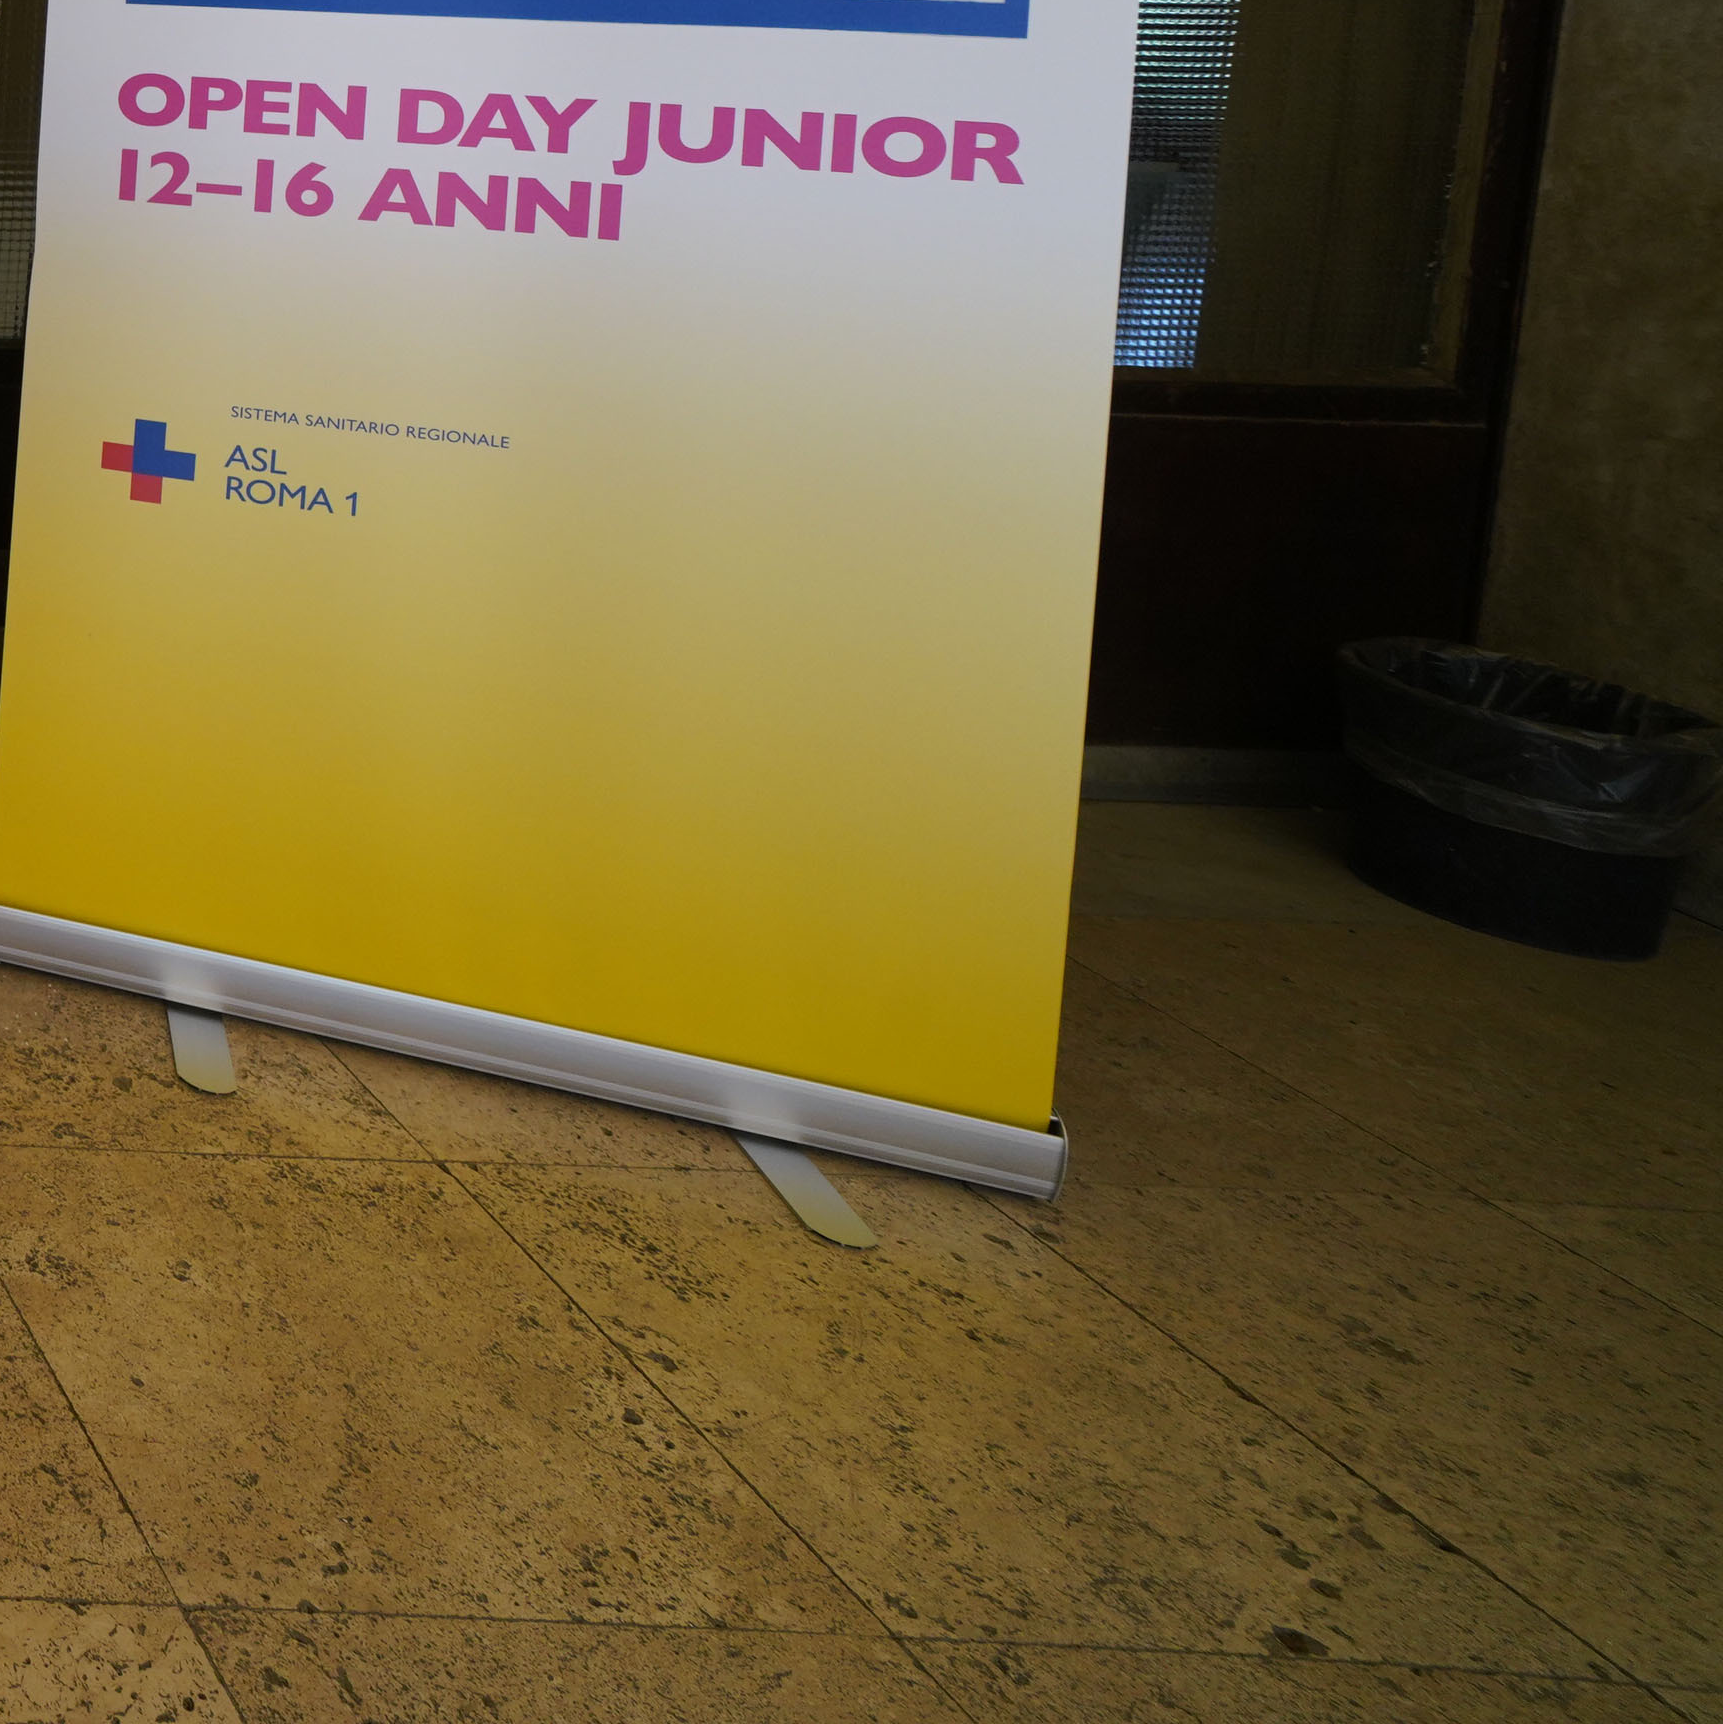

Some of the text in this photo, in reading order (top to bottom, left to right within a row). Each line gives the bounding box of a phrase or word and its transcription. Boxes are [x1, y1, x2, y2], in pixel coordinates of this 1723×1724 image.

[117, 72, 1025, 185] OPEN DAY JUNIOR
[357, 166, 624, 242] ANNI
[230, 404, 511, 450] SISTEMA SANITARIO REGIONALE
[224, 443, 288, 476] ASL
[224, 476, 359, 518] ROMA 1
